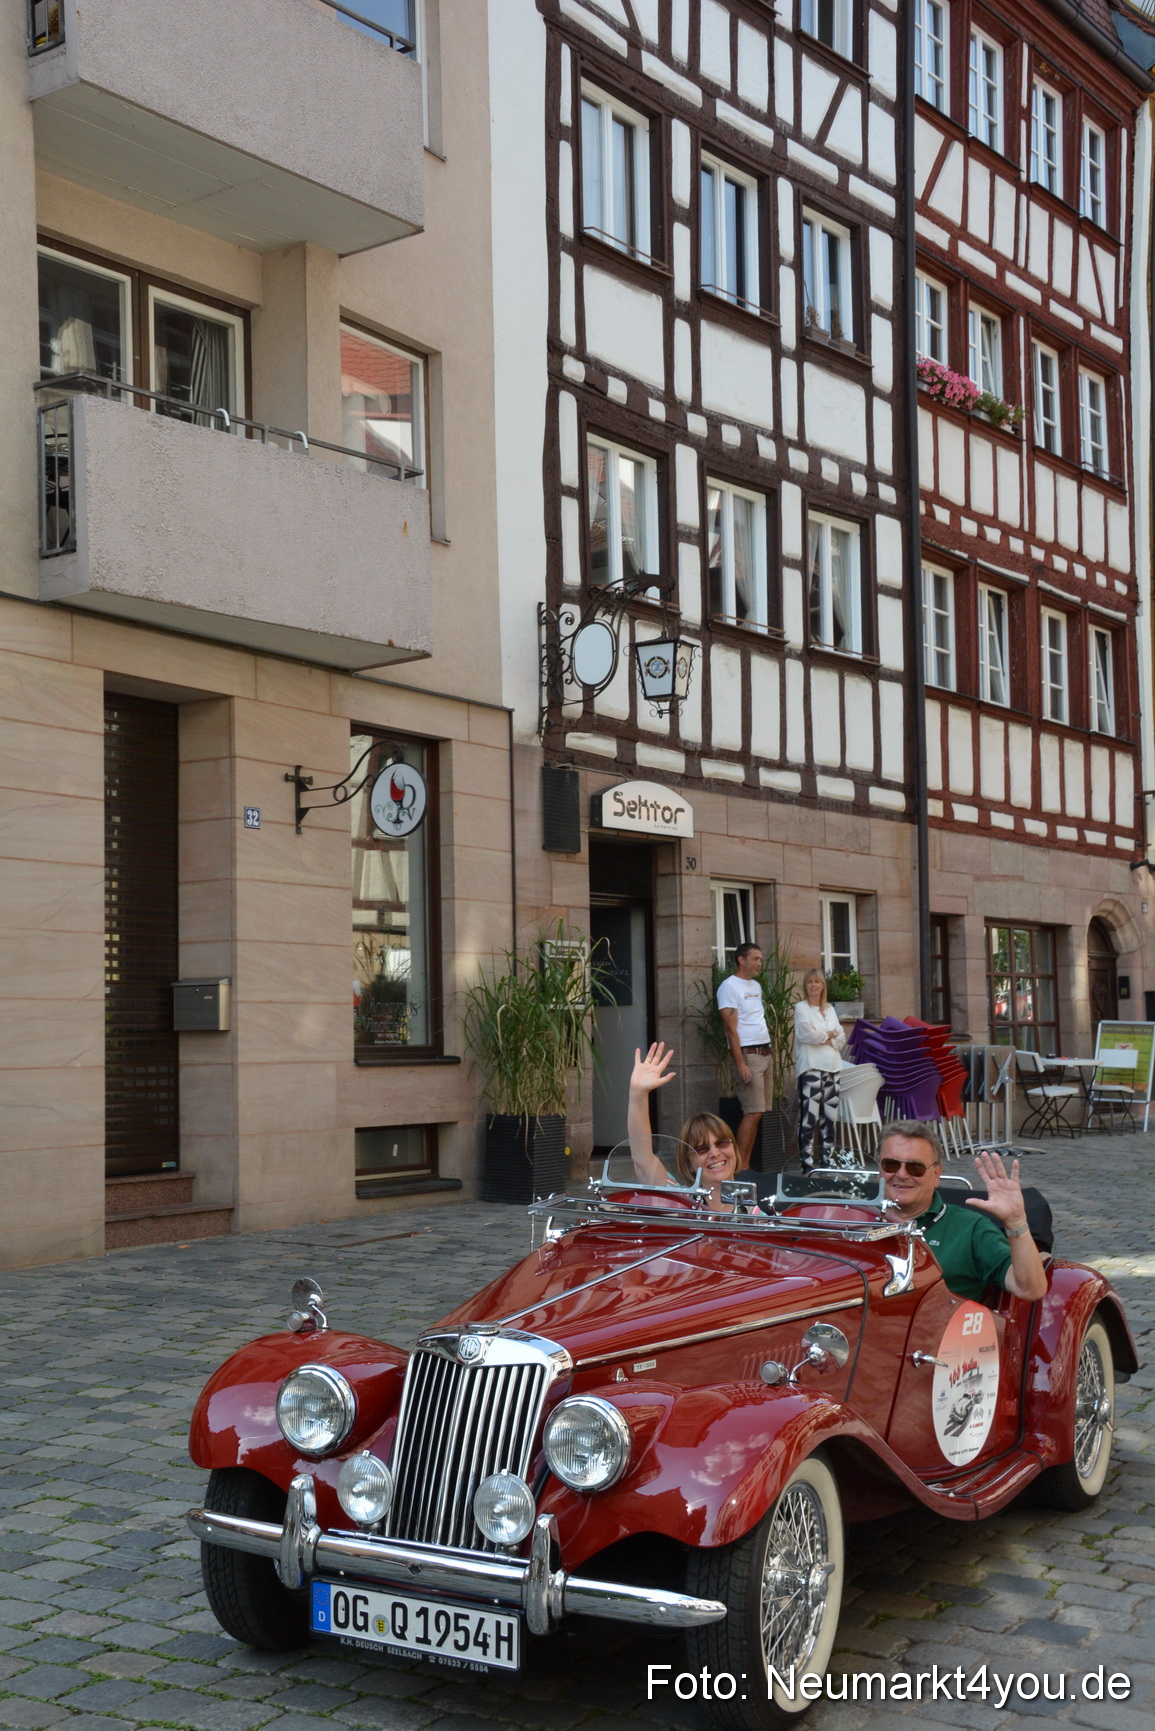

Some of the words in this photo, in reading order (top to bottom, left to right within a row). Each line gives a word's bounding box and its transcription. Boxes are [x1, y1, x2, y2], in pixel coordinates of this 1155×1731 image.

[247, 809, 259, 826] 32
[613, 791, 685, 825] Sektor
[962, 1312, 984, 1336] 28
[461, 1340, 479, 1359] MG
[318, 1611, 325, 1622] D
[333, 1590, 369, 1633] OG
[355, 1639, 384, 1653] DEUSCH
[387, 1647, 423, 1661] SEELBACH
